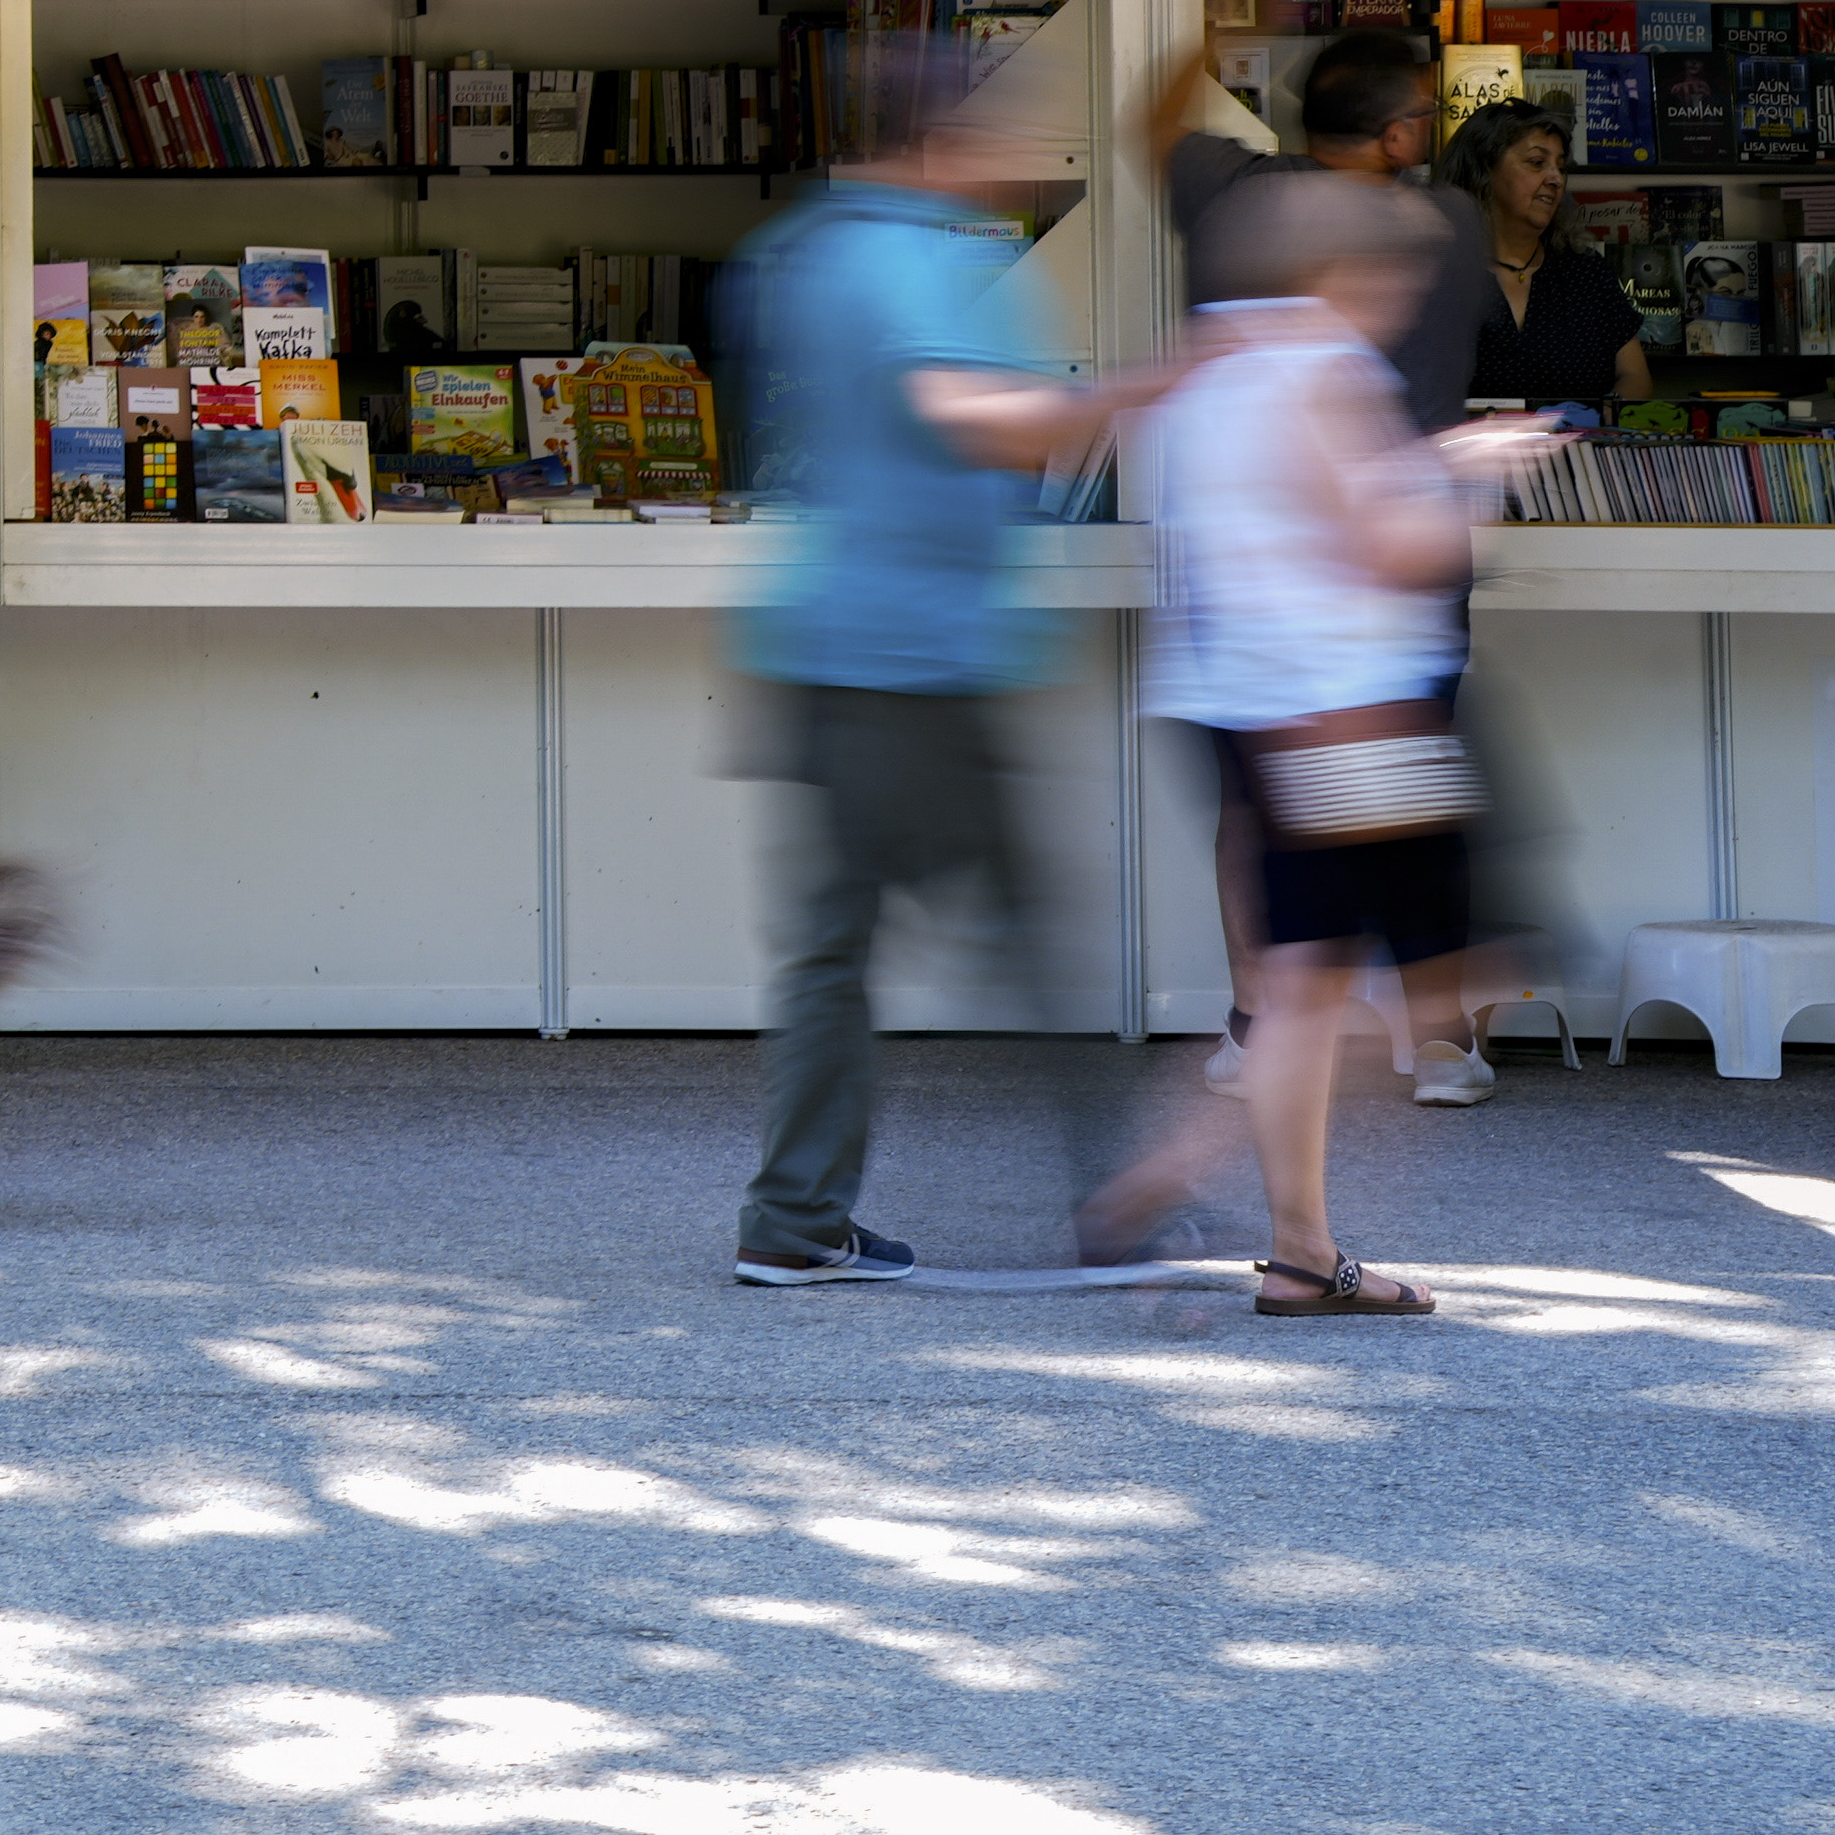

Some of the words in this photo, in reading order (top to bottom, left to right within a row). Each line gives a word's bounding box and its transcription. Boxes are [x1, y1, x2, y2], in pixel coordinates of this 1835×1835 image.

[1346, 5, 1405, 17] EMPERADOR
[1650, 11, 1697, 26] COLLEEN
[1565, 29, 1632, 53] NIEBLA
[1641, 24, 1706, 44] HOOVER
[1727, 29, 1788, 44] DENTRO
[1748, 43, 1768, 55] DE
[1451, 83, 1500, 99] ALAS
[1756, 79, 1790, 93] AÚN
[336, 87, 374, 101] Atem
[455, 91, 508, 103] GOETHE
[1748, 93, 1801, 107] SIGUEN
[340, 108, 372, 123] Welt
[1756, 105, 1793, 120] AQUÍ
[1743, 141, 1768, 153] LISA
[1768, 141, 1810, 154] JEWELL
[1589, 206, 1622, 222] pesar
[949, 225, 1020, 239] Bildermaus
[177, 277, 220, 288] CLARA
[255, 325, 317, 343] Komplett
[260, 340, 313, 360] Kafka
[620, 364, 645, 374] Mein
[281, 374, 318, 382] MISS
[442, 374, 460, 382] Wir
[602, 370, 687, 384] Wimmelhaus
[272, 383, 327, 392] MERKEL
[442, 380, 492, 394] spielen
[431, 393, 509, 409] Einkaufen
[75, 430, 123, 440] Johannes
[292, 423, 324, 435] JULI
[330, 423, 363, 436] ZEH
[89, 439, 123, 448] FRIED
